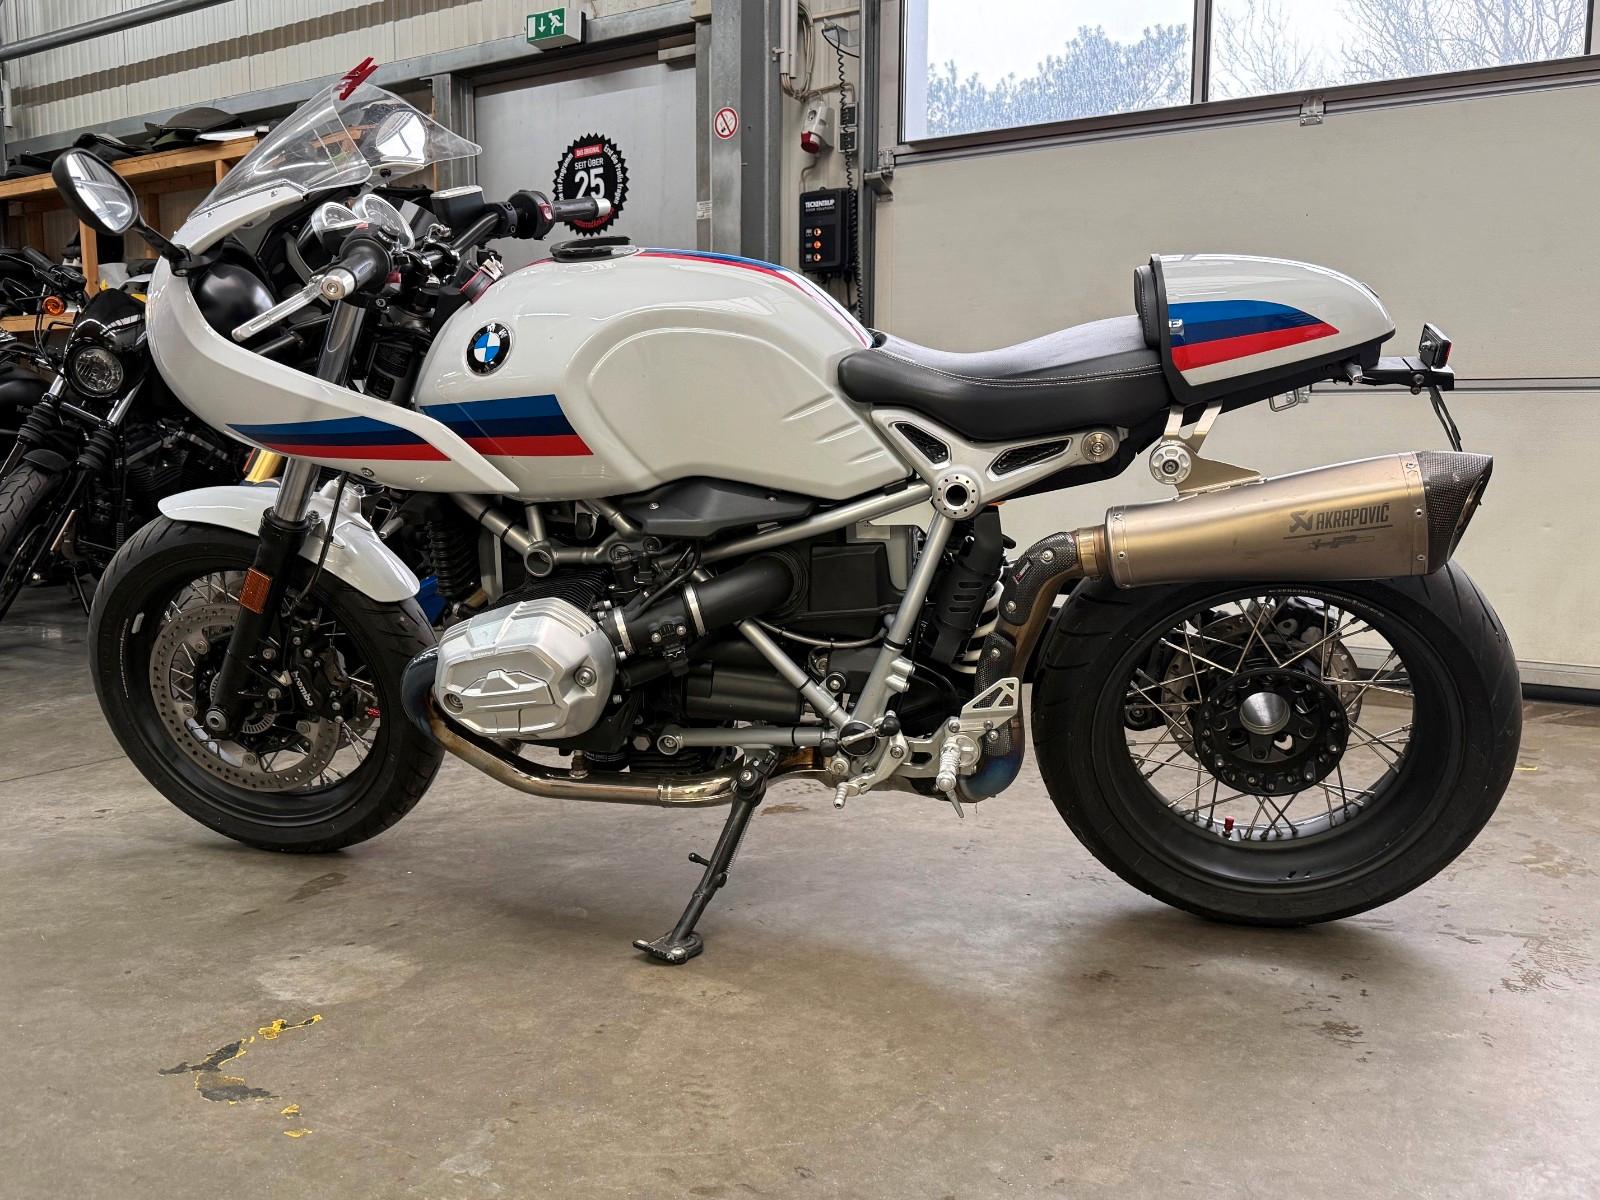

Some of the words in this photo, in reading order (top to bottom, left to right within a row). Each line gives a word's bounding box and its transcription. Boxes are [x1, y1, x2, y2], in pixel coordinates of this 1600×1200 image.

[603, 144, 614, 157] Erst
[557, 153, 574, 183] Programm
[574, 161, 587, 170] SEIT
[587, 157, 604, 168] ÜBER
[615, 163, 624, 183] Profis
[574, 167, 605, 199] 25
[613, 184, 624, 205] fragen
[291, 670, 314, 706] brembo
